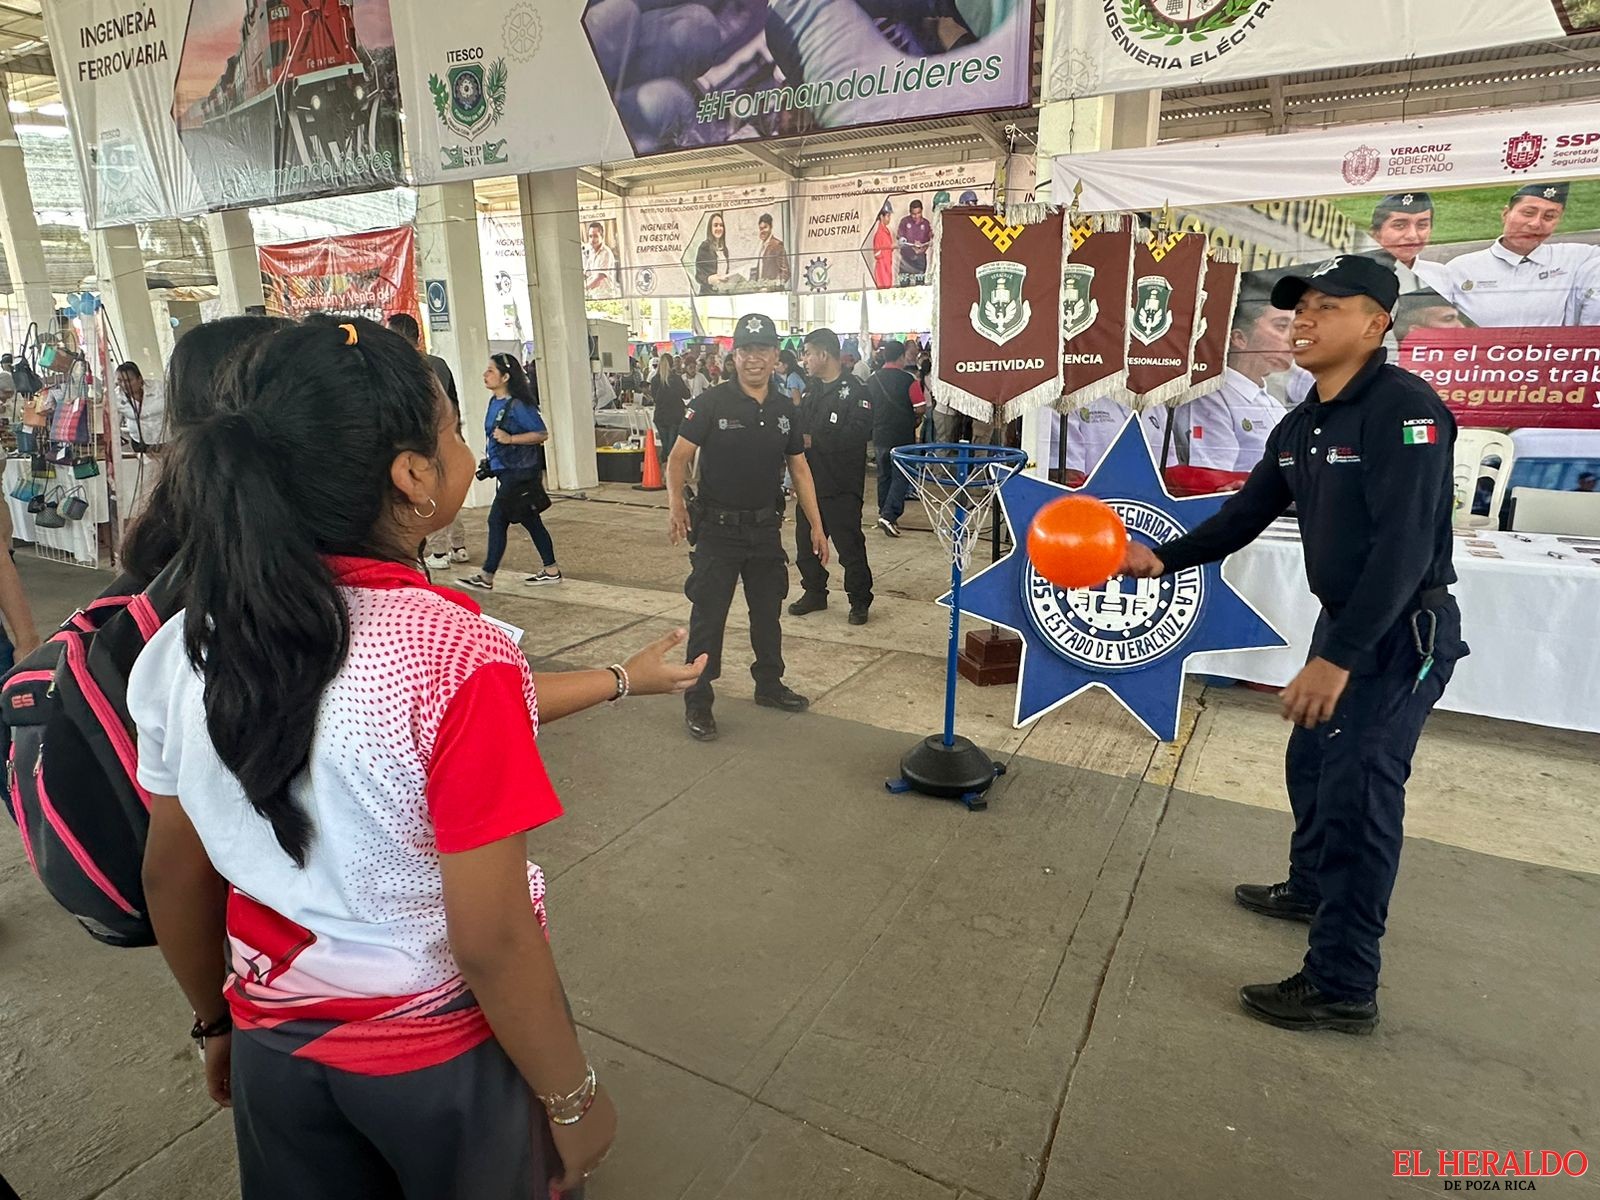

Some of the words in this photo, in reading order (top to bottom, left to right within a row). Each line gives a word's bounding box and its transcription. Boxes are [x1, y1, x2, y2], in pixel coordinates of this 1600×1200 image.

[80, 3, 157, 48] INGENIERÍA
[1190, 0, 1274, 67] ELÉCTR
[78, 40, 168, 82] FERROVIARIA
[446, 47, 484, 63] ITESCO
[696, 54, 1003, 123] #FormandoLíderes
[1555, 133, 1600, 147] SSP
[463, 145, 482, 156] SEP
[1391, 143, 1452, 155] VERACRUZ
[1388, 153, 1446, 166] GOBIERNO
[1551, 156, 1598, 167] Seguridad
[1387, 166, 1407, 176] DEL
[1410, 162, 1454, 174] ESTADO
[808, 208, 860, 225] INGENIERÍA
[641, 221, 679, 232] INGENIERÍA
[808, 224, 860, 238] INDUSTRIAL
[639, 234, 649, 243] EN
[649, 231, 680, 242] GESTIÓN
[636, 243, 682, 254] EMPRESARIAL
[291, 292, 338, 308] Exposición
[347, 291, 375, 305] Venta
[1062, 353, 1104, 365] ENCIA
[1411, 345, 1444, 361] En
[1453, 345, 1478, 361] el
[1487, 343, 1600, 361] Gobiern
[955, 358, 1045, 373] OBJETIVIDAD
[1127, 357, 1183, 368] ESIONALISMO
[1437, 384, 1587, 406] seguridad
[1112, 506, 1180, 544] EGURIDA
[1045, 612, 1093, 656] ESTADO
[1096, 642, 1113, 661] DE
[1117, 613, 1185, 661] VERACRUZ
